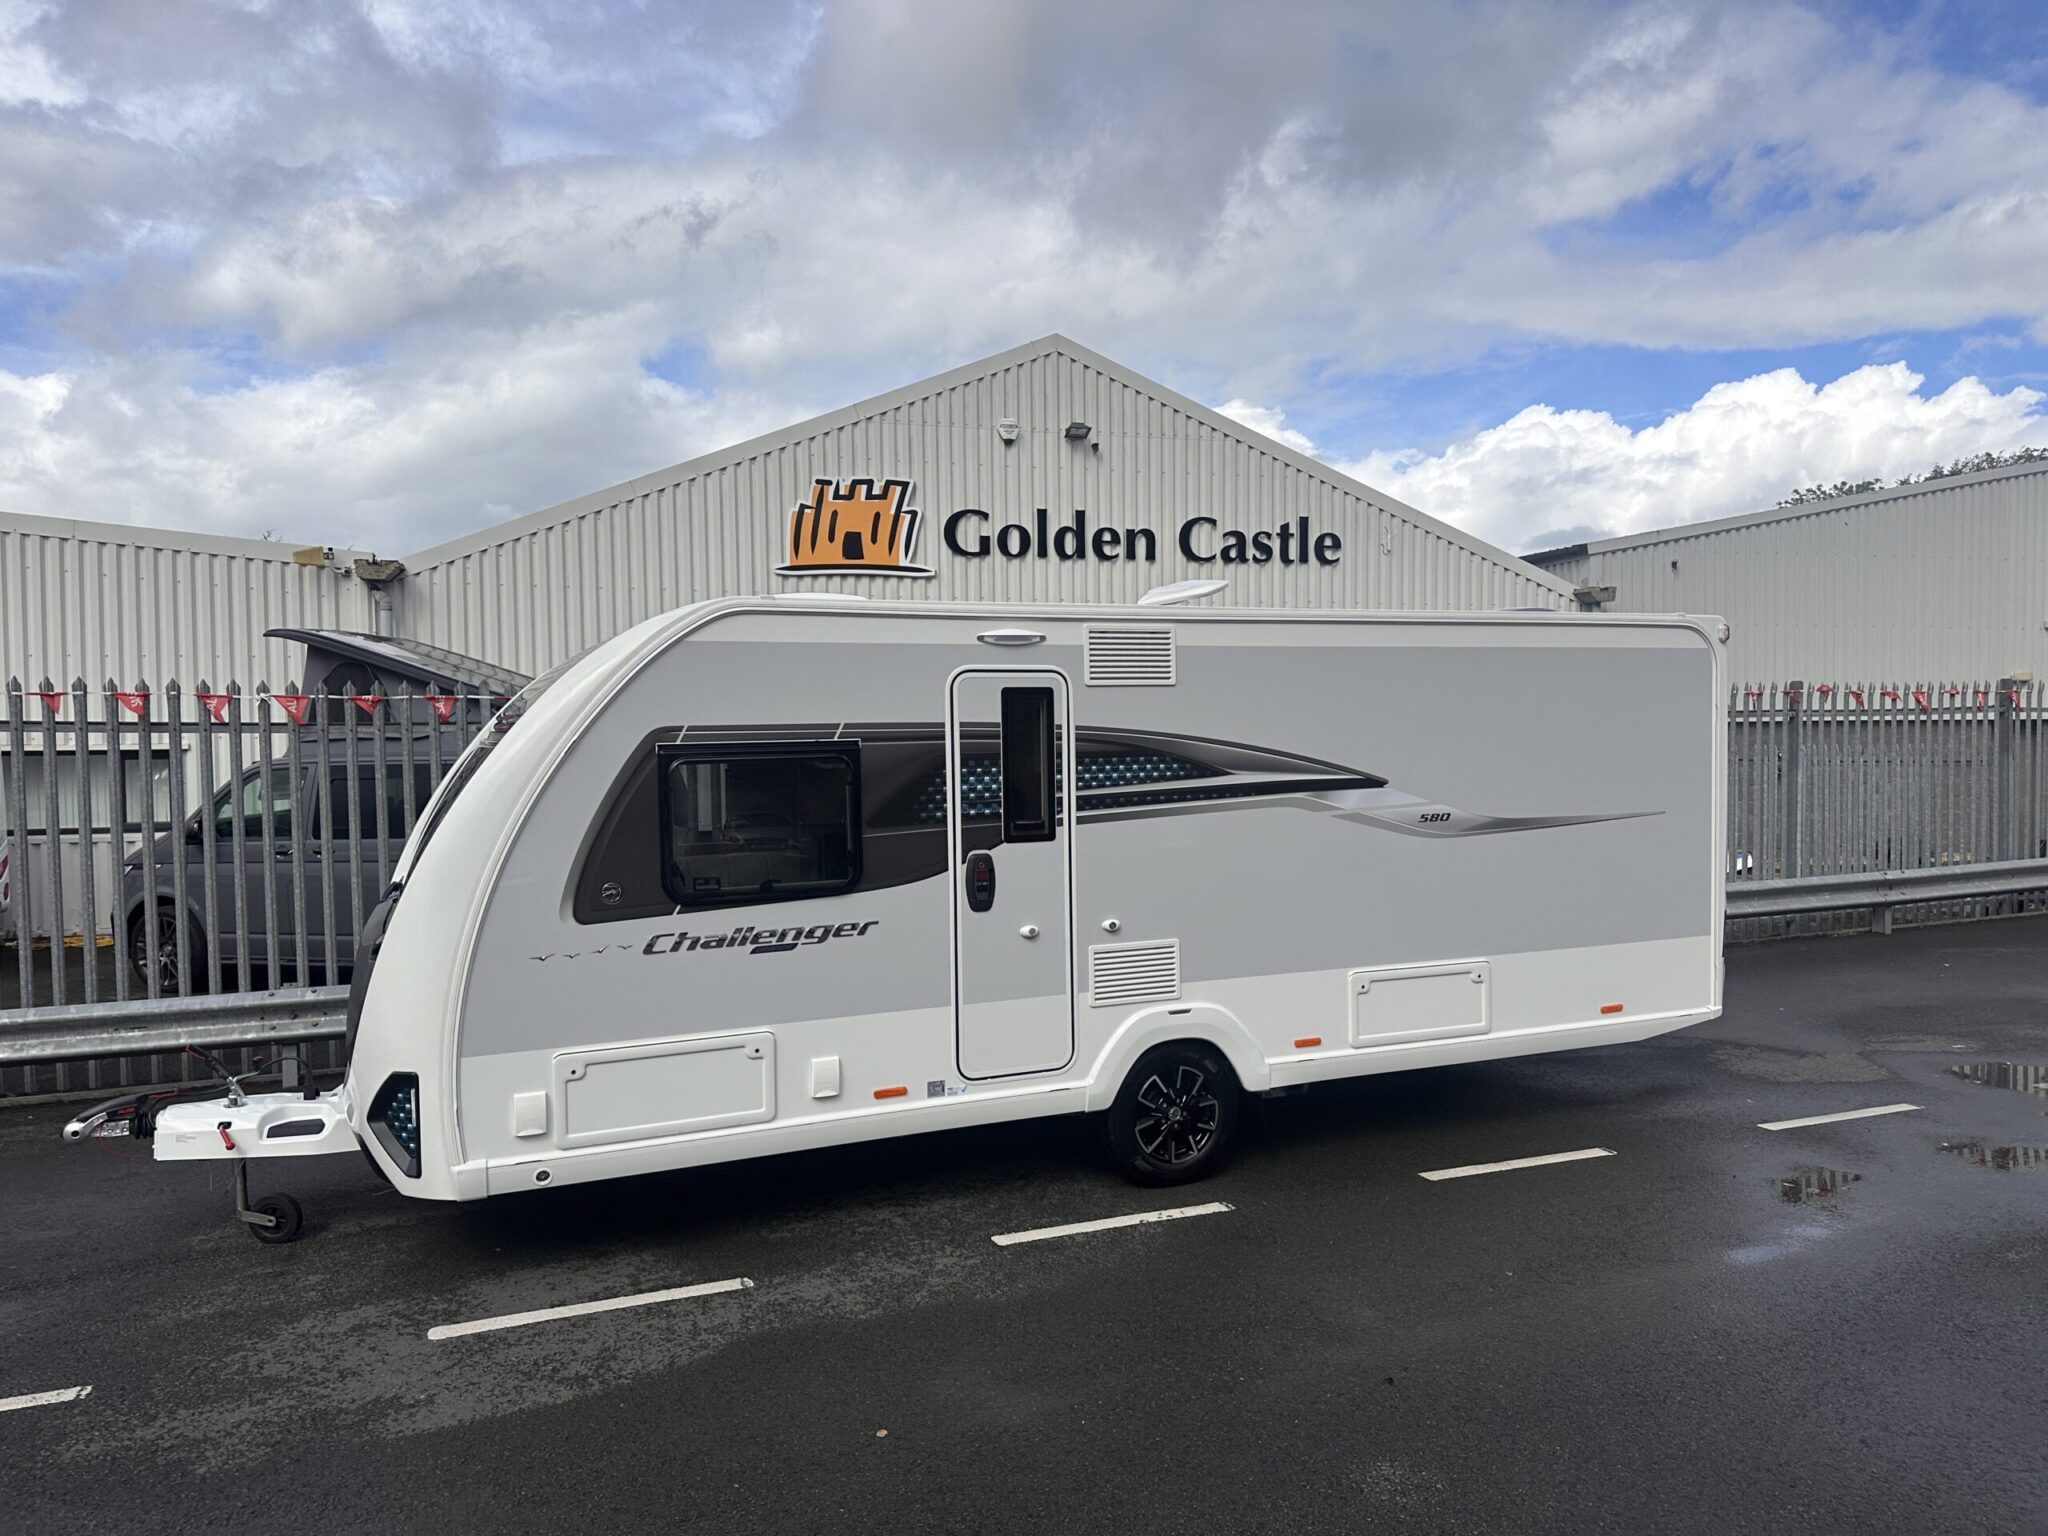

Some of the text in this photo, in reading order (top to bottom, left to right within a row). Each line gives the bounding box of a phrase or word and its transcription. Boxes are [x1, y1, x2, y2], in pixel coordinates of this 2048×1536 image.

[943, 507, 1343, 566] Golden Castle
[1418, 812, 1451, 823] 580
[642, 920, 880, 955] Challenger
